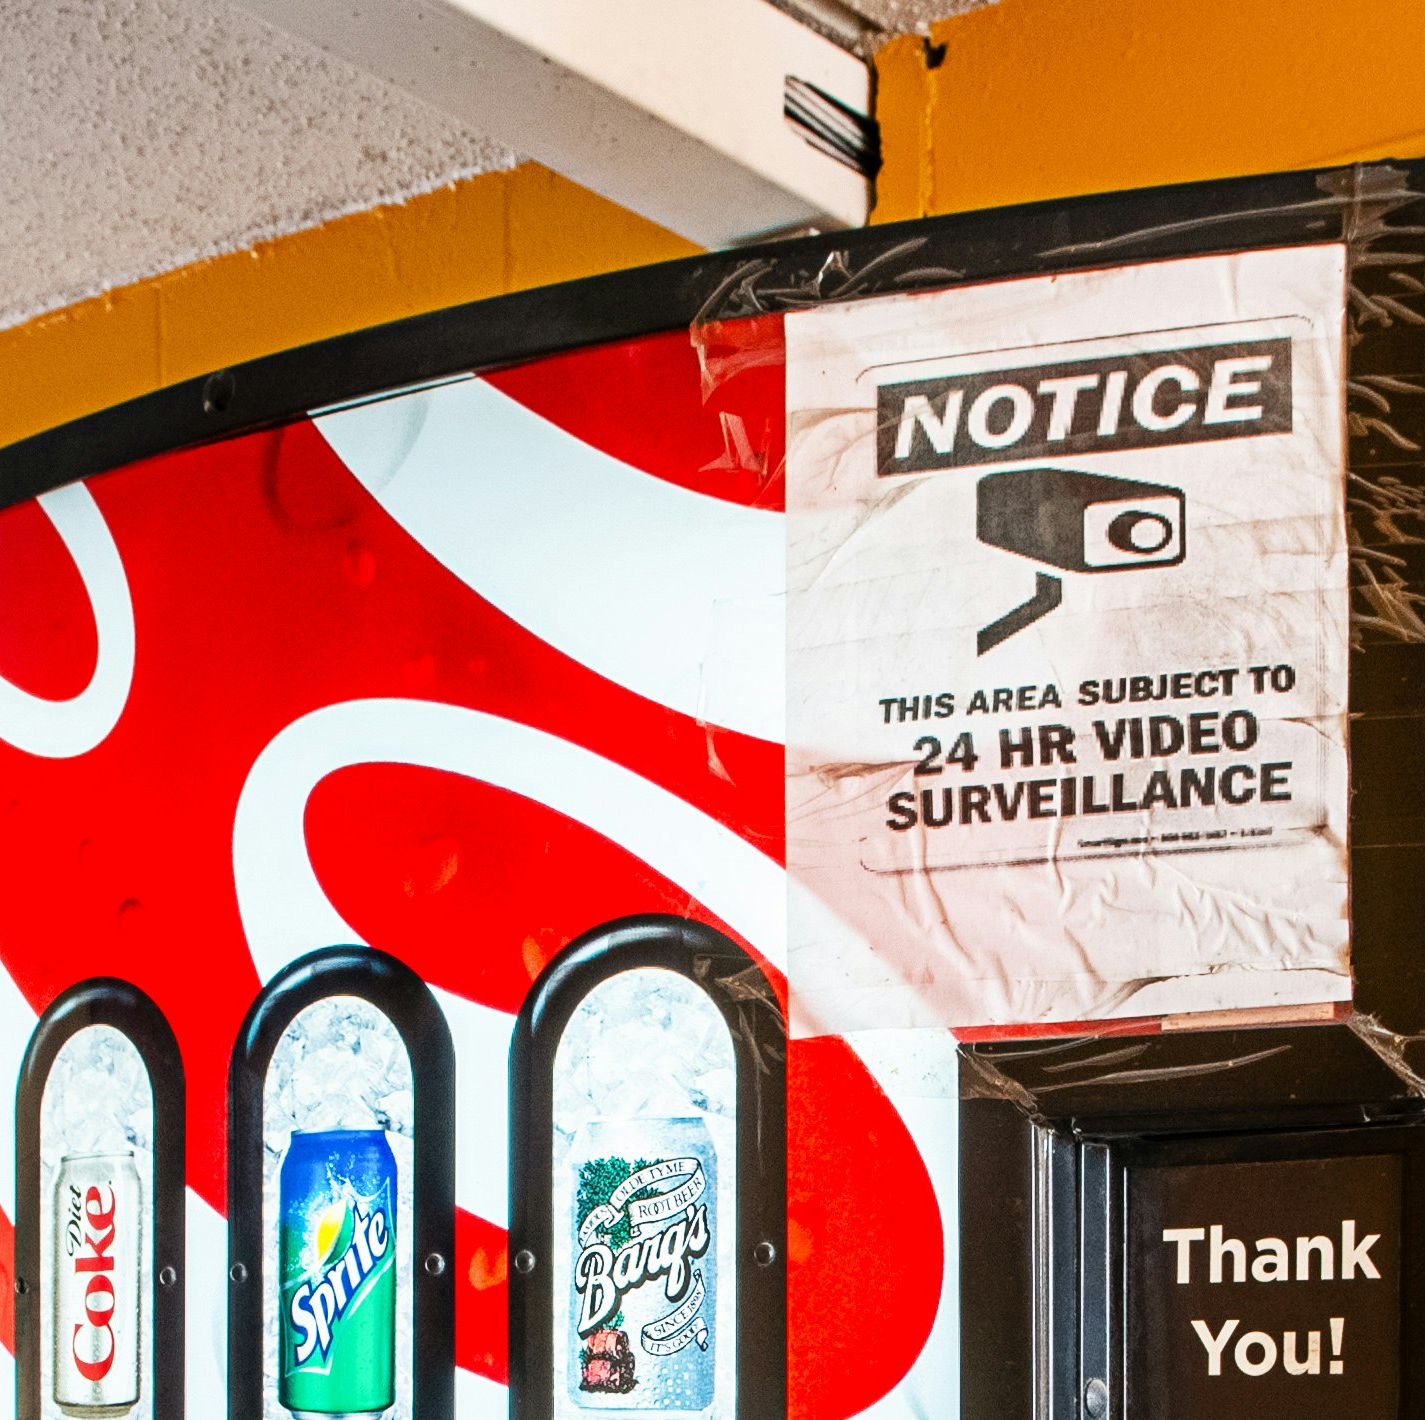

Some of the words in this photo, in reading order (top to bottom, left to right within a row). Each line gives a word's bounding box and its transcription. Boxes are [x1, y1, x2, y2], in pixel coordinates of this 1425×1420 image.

[893, 354, 1275, 459] NOTICE
[879, 693, 955, 724] THIS
[966, 683, 1062, 715] AREA
[1078, 668, 1239, 706] SUBJECT
[1248, 664, 1295, 694] TO
[913, 732, 978, 777] 24
[999, 723, 1076, 769] HR
[1092, 709, 1260, 761] VIDEO
[886, 761, 1293, 832] SURVEILLANCE
[615, 1174, 645, 1202] OLDE
[649, 1161, 687, 1178] TYME
[638, 1198, 671, 1218] ROOT
[674, 1177, 702, 1202] BEER
[66, 1185, 82, 1257] Diet
[1163, 1219, 1381, 1284] Thank
[73, 1186, 115, 1381] Coke
[290, 1198, 389, 1365] Sprite
[575, 1203, 710, 1340] Barq's
[650, 1341, 671, 1352] IT'S
[653, 1310, 686, 1337] SINCE
[1191, 1317, 1345, 1377] You!
